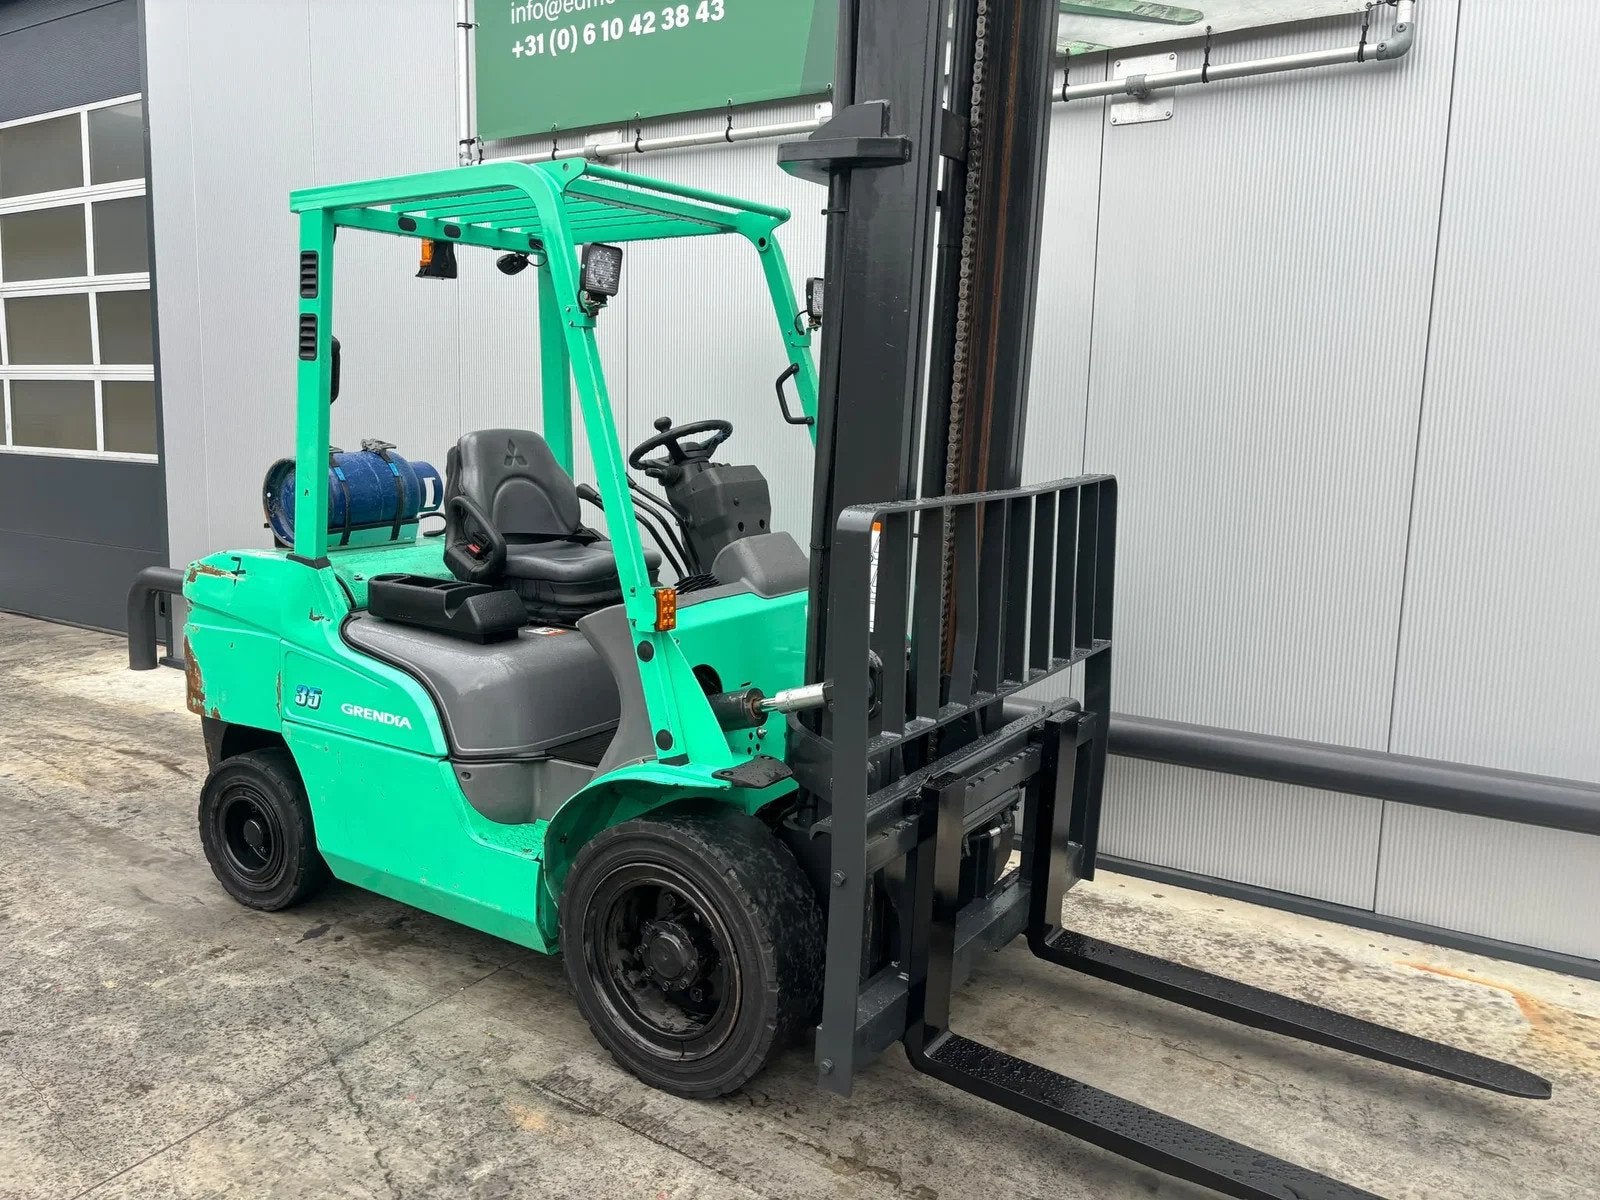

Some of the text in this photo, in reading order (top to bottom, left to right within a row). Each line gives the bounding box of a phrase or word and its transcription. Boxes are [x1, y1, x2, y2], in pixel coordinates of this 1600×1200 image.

[511, 0, 616, 24] info@e
[511, 0, 725, 58] +31 (0) 6 10 42 38 43
[295, 684, 322, 709] 35
[340, 703, 412, 729] GRENDIA
